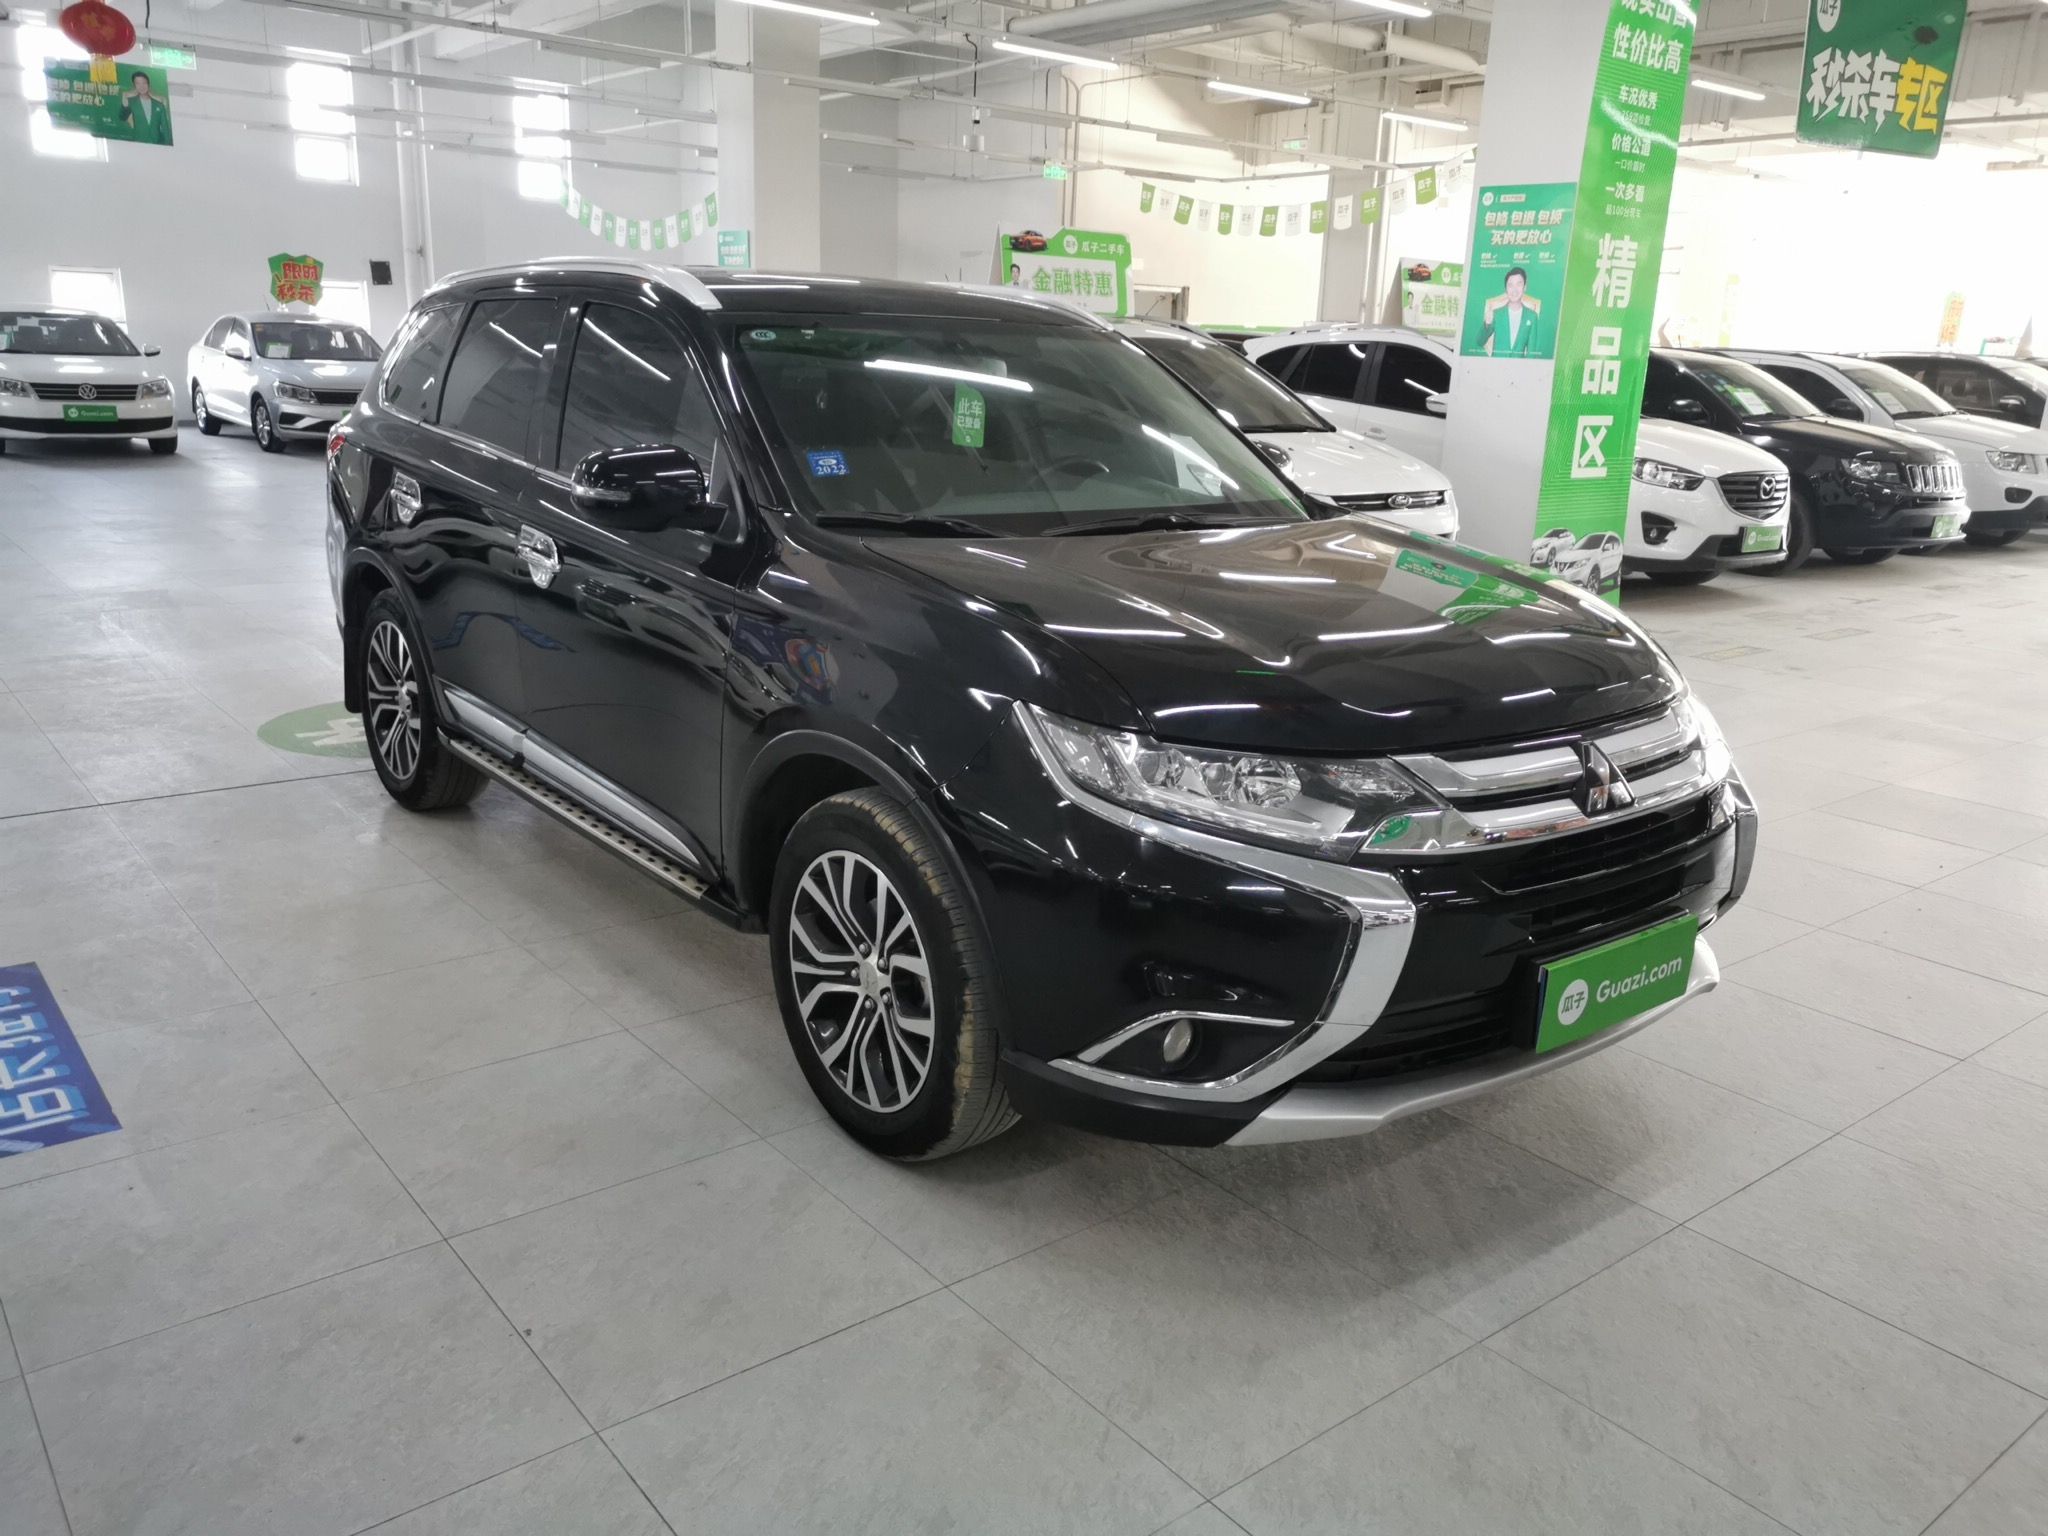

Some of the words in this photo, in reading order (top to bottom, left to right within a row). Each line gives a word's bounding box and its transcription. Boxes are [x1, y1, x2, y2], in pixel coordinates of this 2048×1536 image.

[1612, 21, 1684, 74] 性价比高
[1082, 240, 1125, 256] 瓜子二手车
[1032, 267, 1113, 297] 金融特惠
[1570, 233, 1638, 479] 精品区
[958, 397, 982, 416] 此车
[815, 464, 847, 475] 2022
[1561, 991, 1585, 1014] 瓜子
[1597, 957, 1682, 1003] Guazi.com
